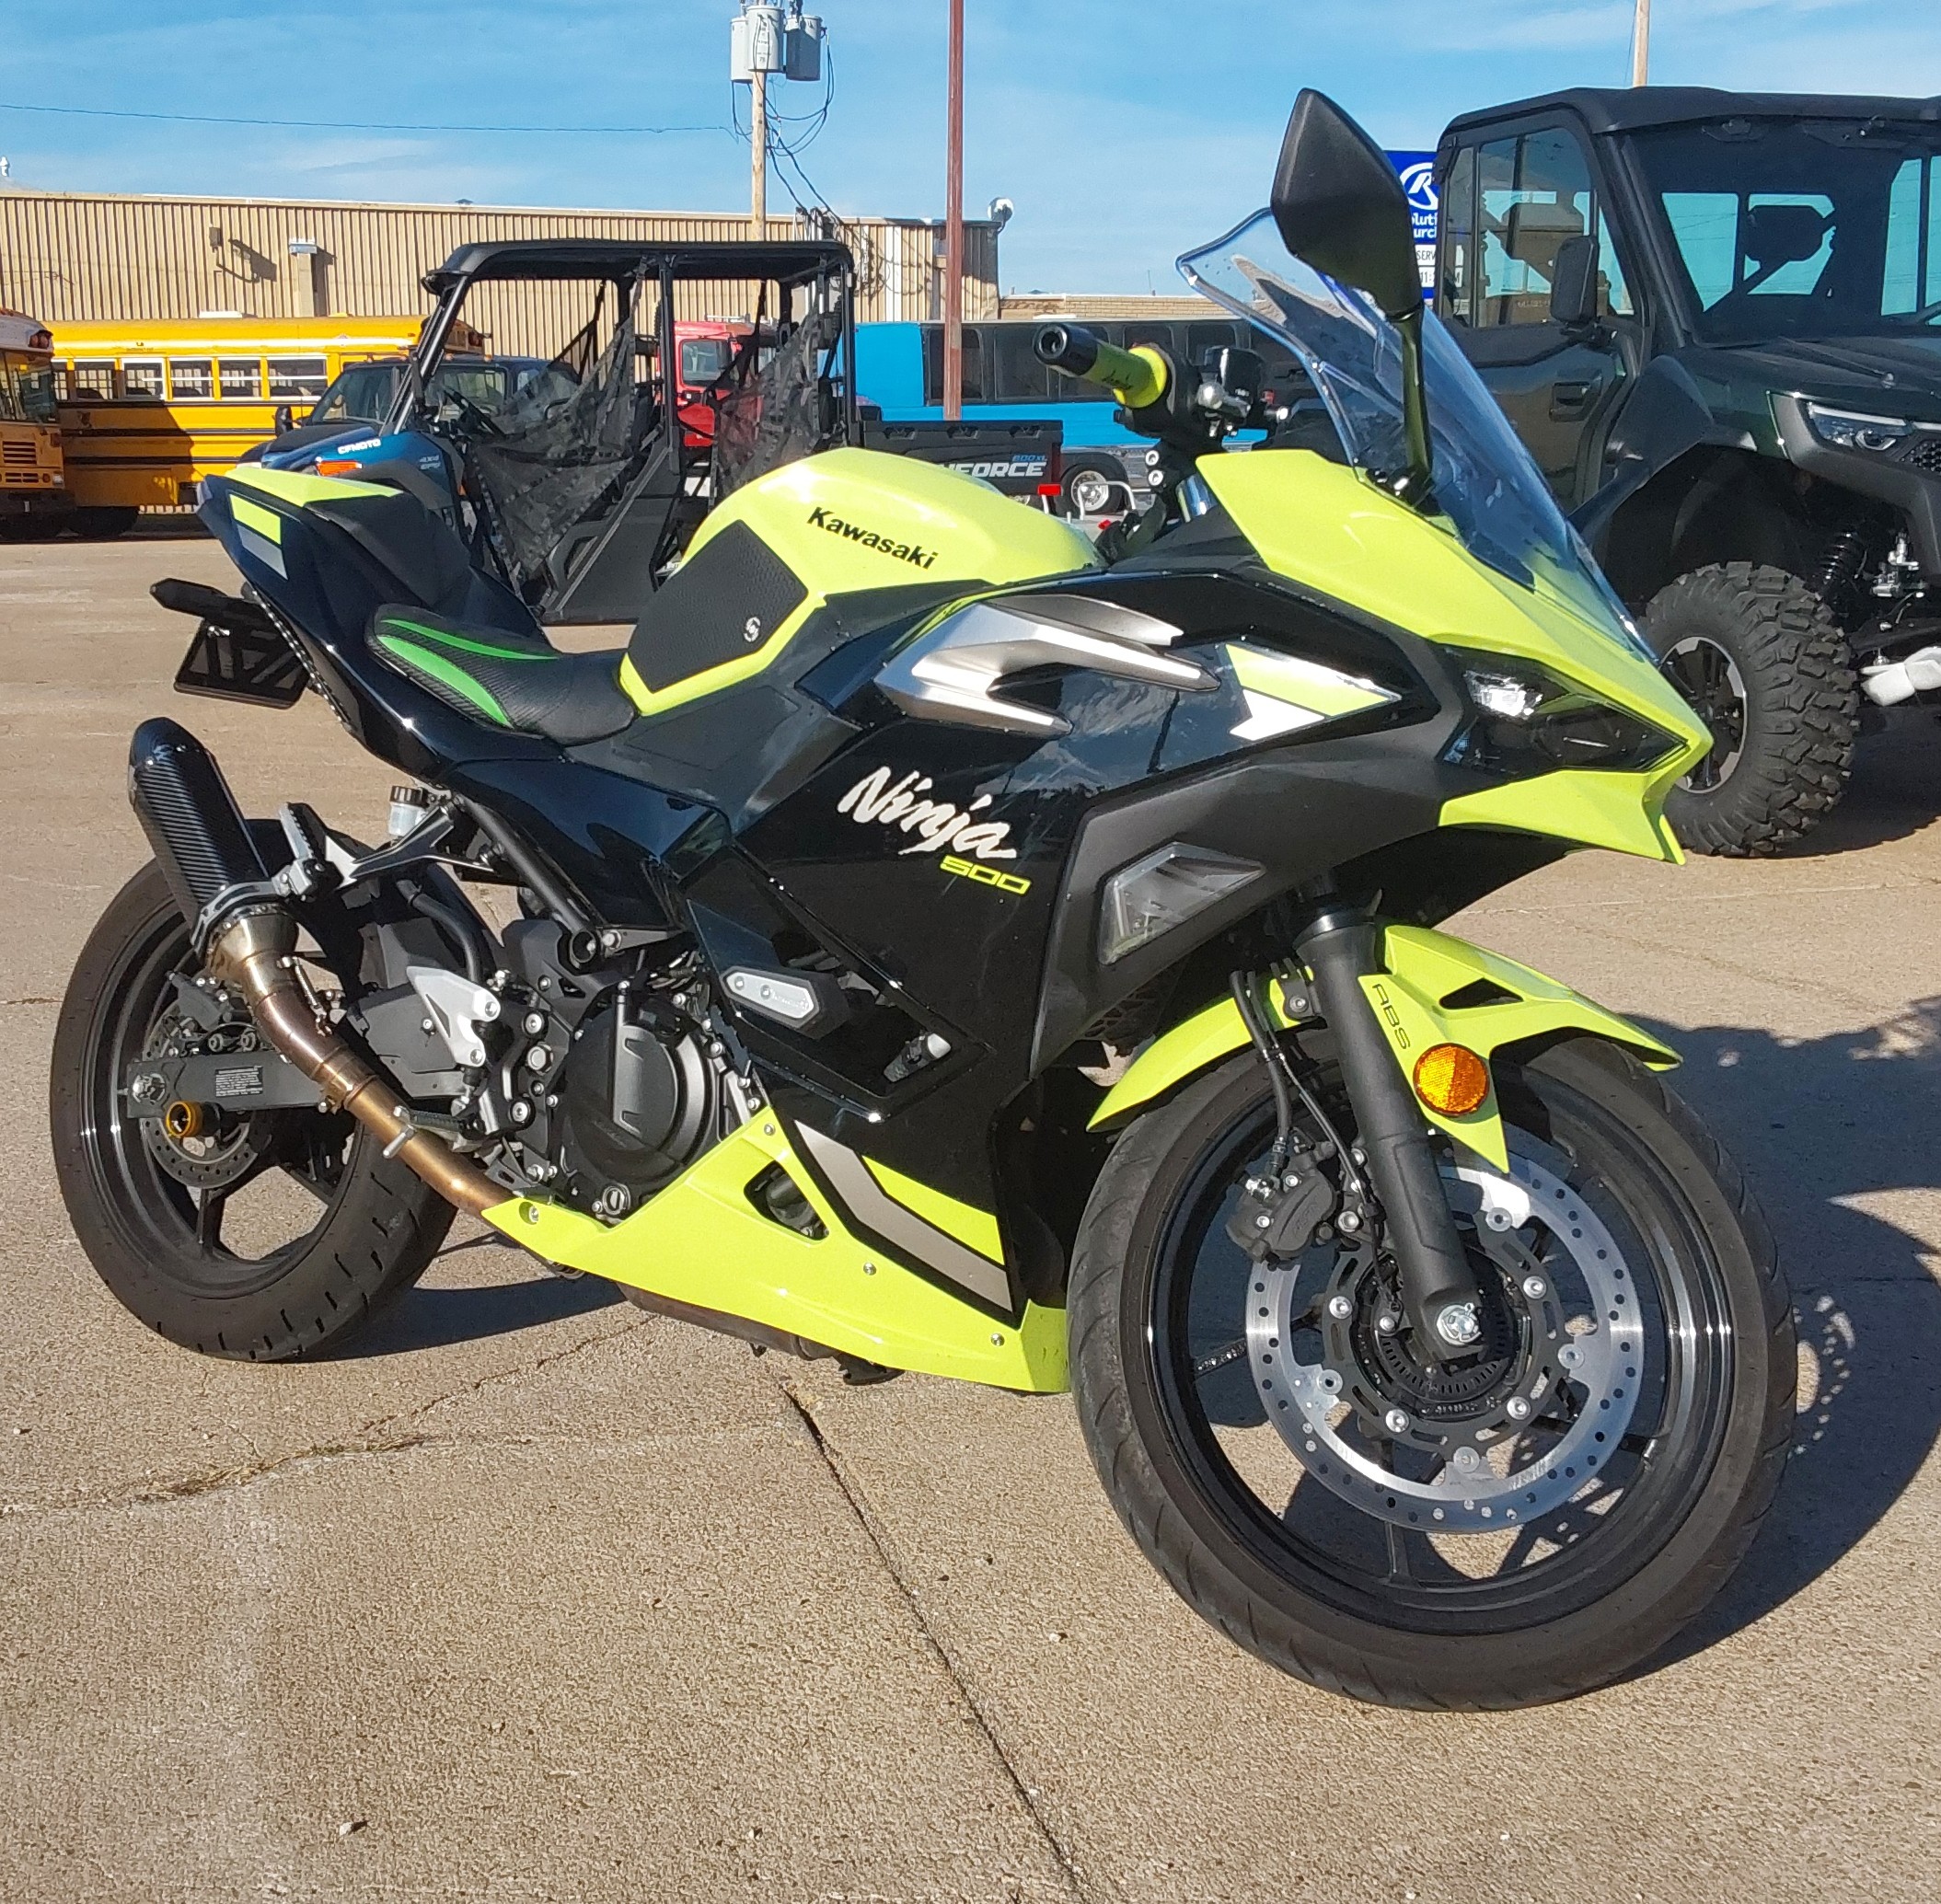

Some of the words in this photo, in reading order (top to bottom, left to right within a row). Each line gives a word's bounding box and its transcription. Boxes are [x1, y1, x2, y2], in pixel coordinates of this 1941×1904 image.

[337, 438, 381, 455] CFMOTO
[806, 506, 939, 571] Kawasaki
[837, 766, 1017, 860] Ninja
[940, 854, 1032, 895] 500
[1371, 983, 1411, 1050] ABS
